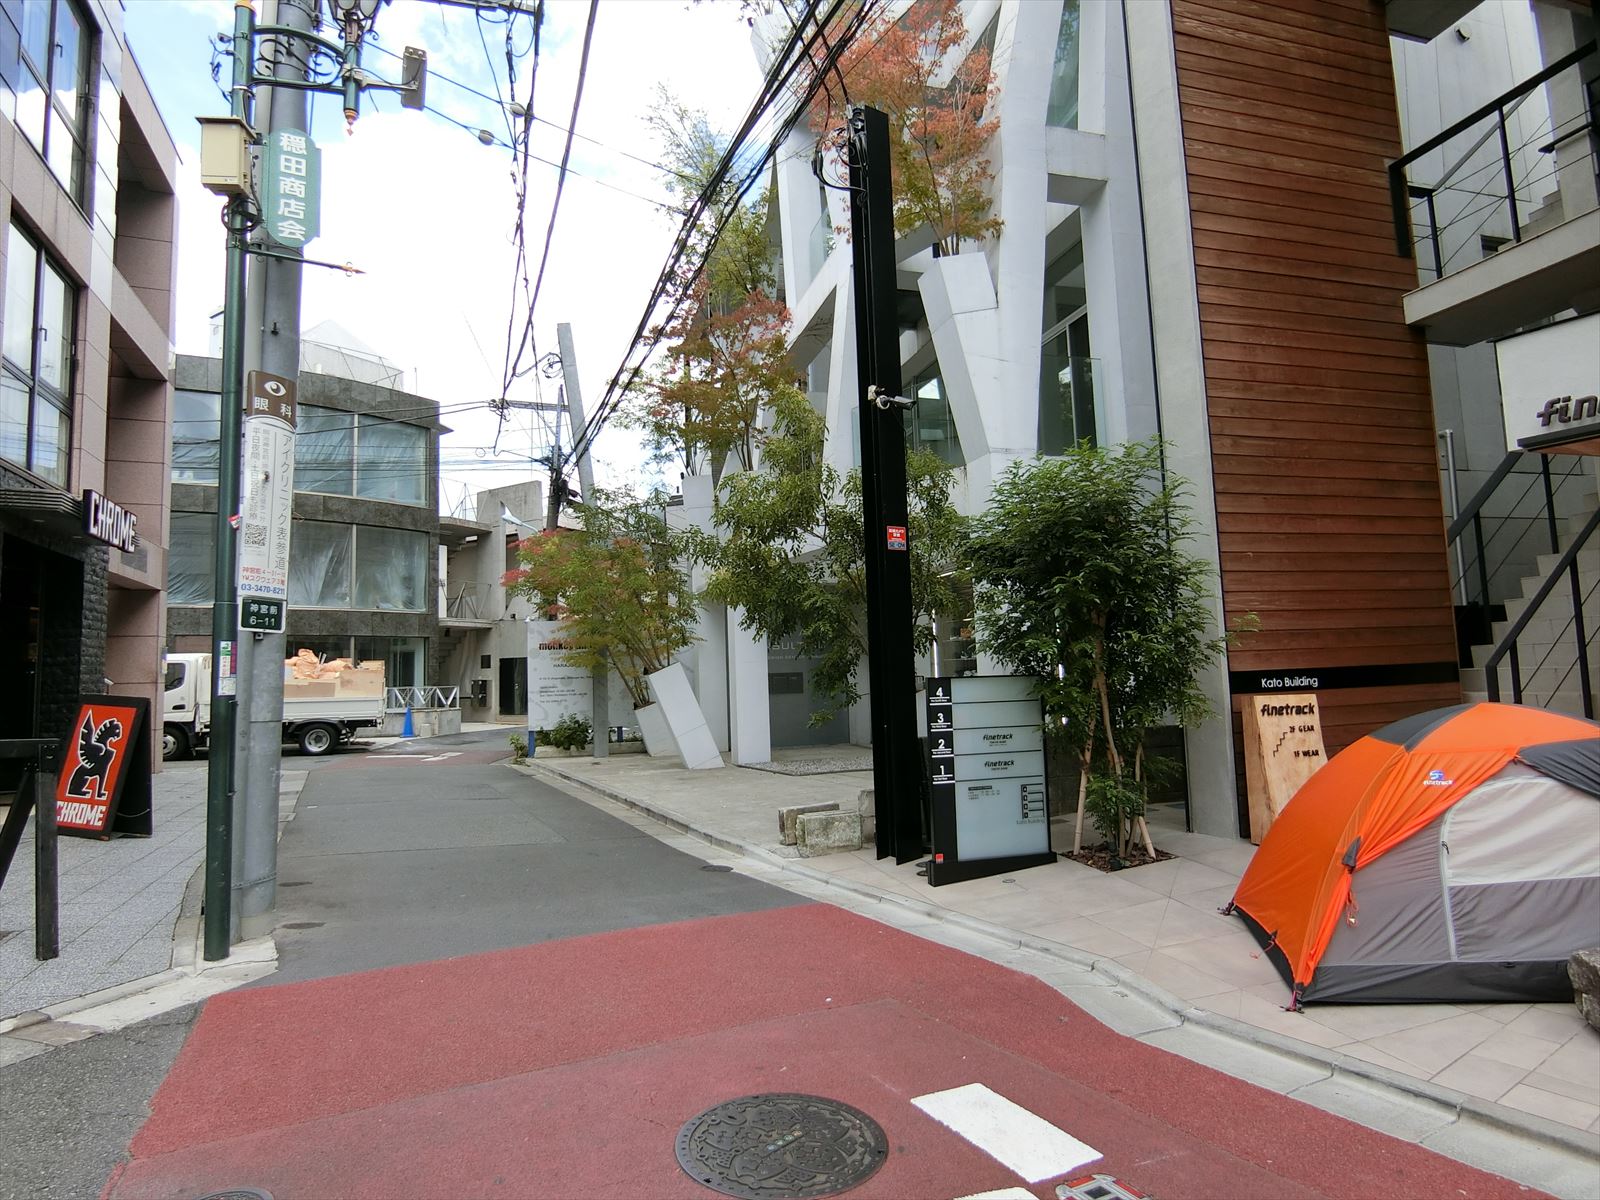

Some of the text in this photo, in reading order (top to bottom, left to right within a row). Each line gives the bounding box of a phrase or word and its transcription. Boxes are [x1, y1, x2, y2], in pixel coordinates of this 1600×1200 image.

[279, 132, 306, 241] 穏田商店会
[1537, 394, 1600, 427] fin
[275, 434, 292, 570] アイクリニック表参道
[90, 491, 137, 552] CHROME
[250, 604, 278, 614] 神宮前
[250, 616, 276, 626] 6-11
[1261, 676, 1318, 688] Kato Building
[936, 686, 943, 697] 4
[1261, 703, 1315, 717] finetrack
[937, 712, 944, 723] 3
[1298, 725, 1315, 733] GEAR
[983, 732, 1013, 740] finetrack
[938, 738, 945, 749] 2
[1301, 749, 1319, 758] WEAR
[984, 760, 1015, 768] finetrack
[940, 765, 945, 776] 1
